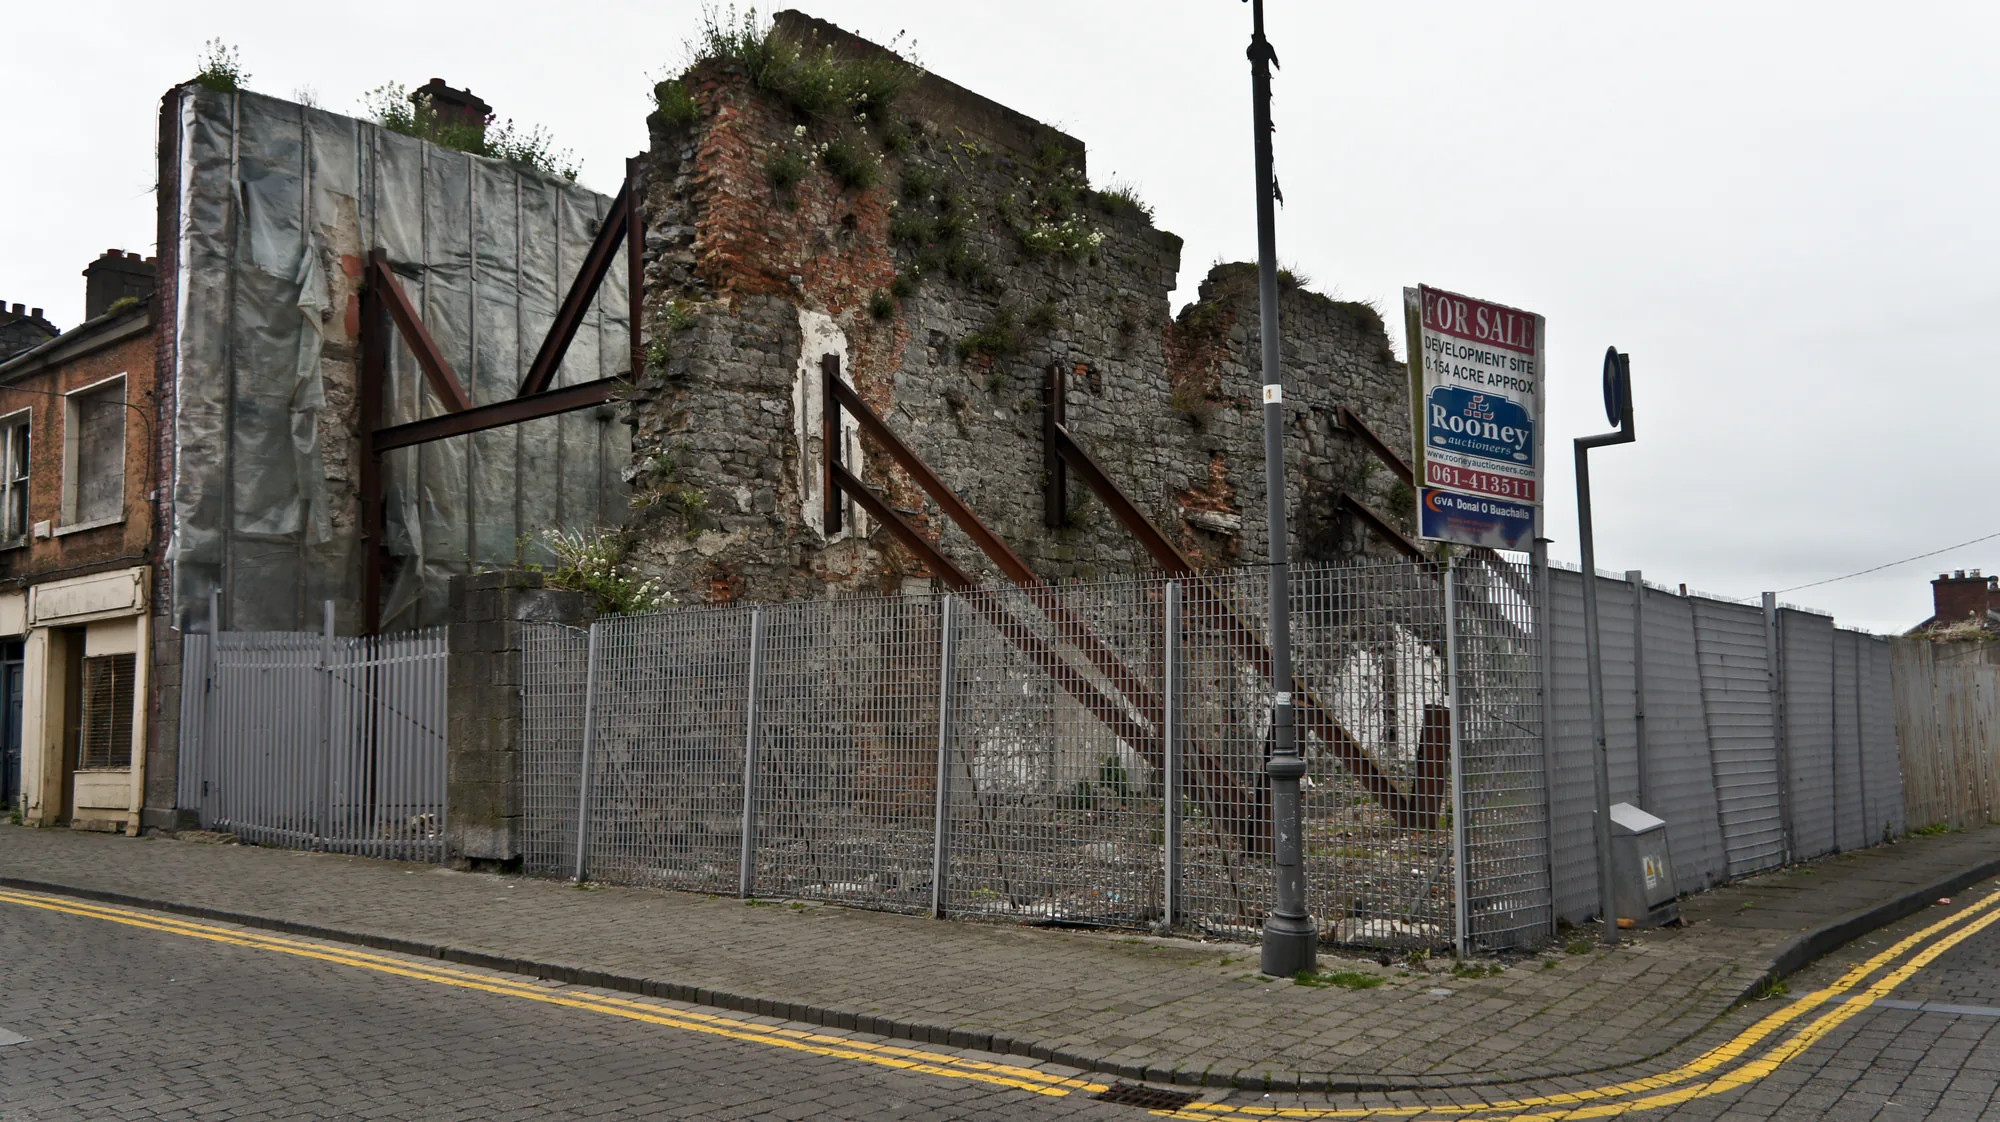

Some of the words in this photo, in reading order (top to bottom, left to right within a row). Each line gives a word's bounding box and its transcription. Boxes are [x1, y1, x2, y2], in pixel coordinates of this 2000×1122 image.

[1424, 291, 1470, 335] FOR
[1475, 307, 1533, 348] SALE
[1425, 336, 1507, 369] DEVELOPMENT
[1510, 358, 1534, 374] SITE
[1425, 356, 1450, 375] 0.154
[1453, 365, 1484, 384] ACRE
[1488, 373, 1534, 394] APPROX
[1431, 404, 1529, 450] Rooney
[1426, 450, 1535, 477] www.rooneyauctioneers.com
[1448, 436, 1512, 455] auctioneers
[1432, 464, 1531, 498] 061-413511
[1434, 496, 1453, 508] GVA
[1457, 498, 1480, 512] Donal
[1482, 504, 1488, 514] O
[1490, 504, 1530, 520] Buachalla
